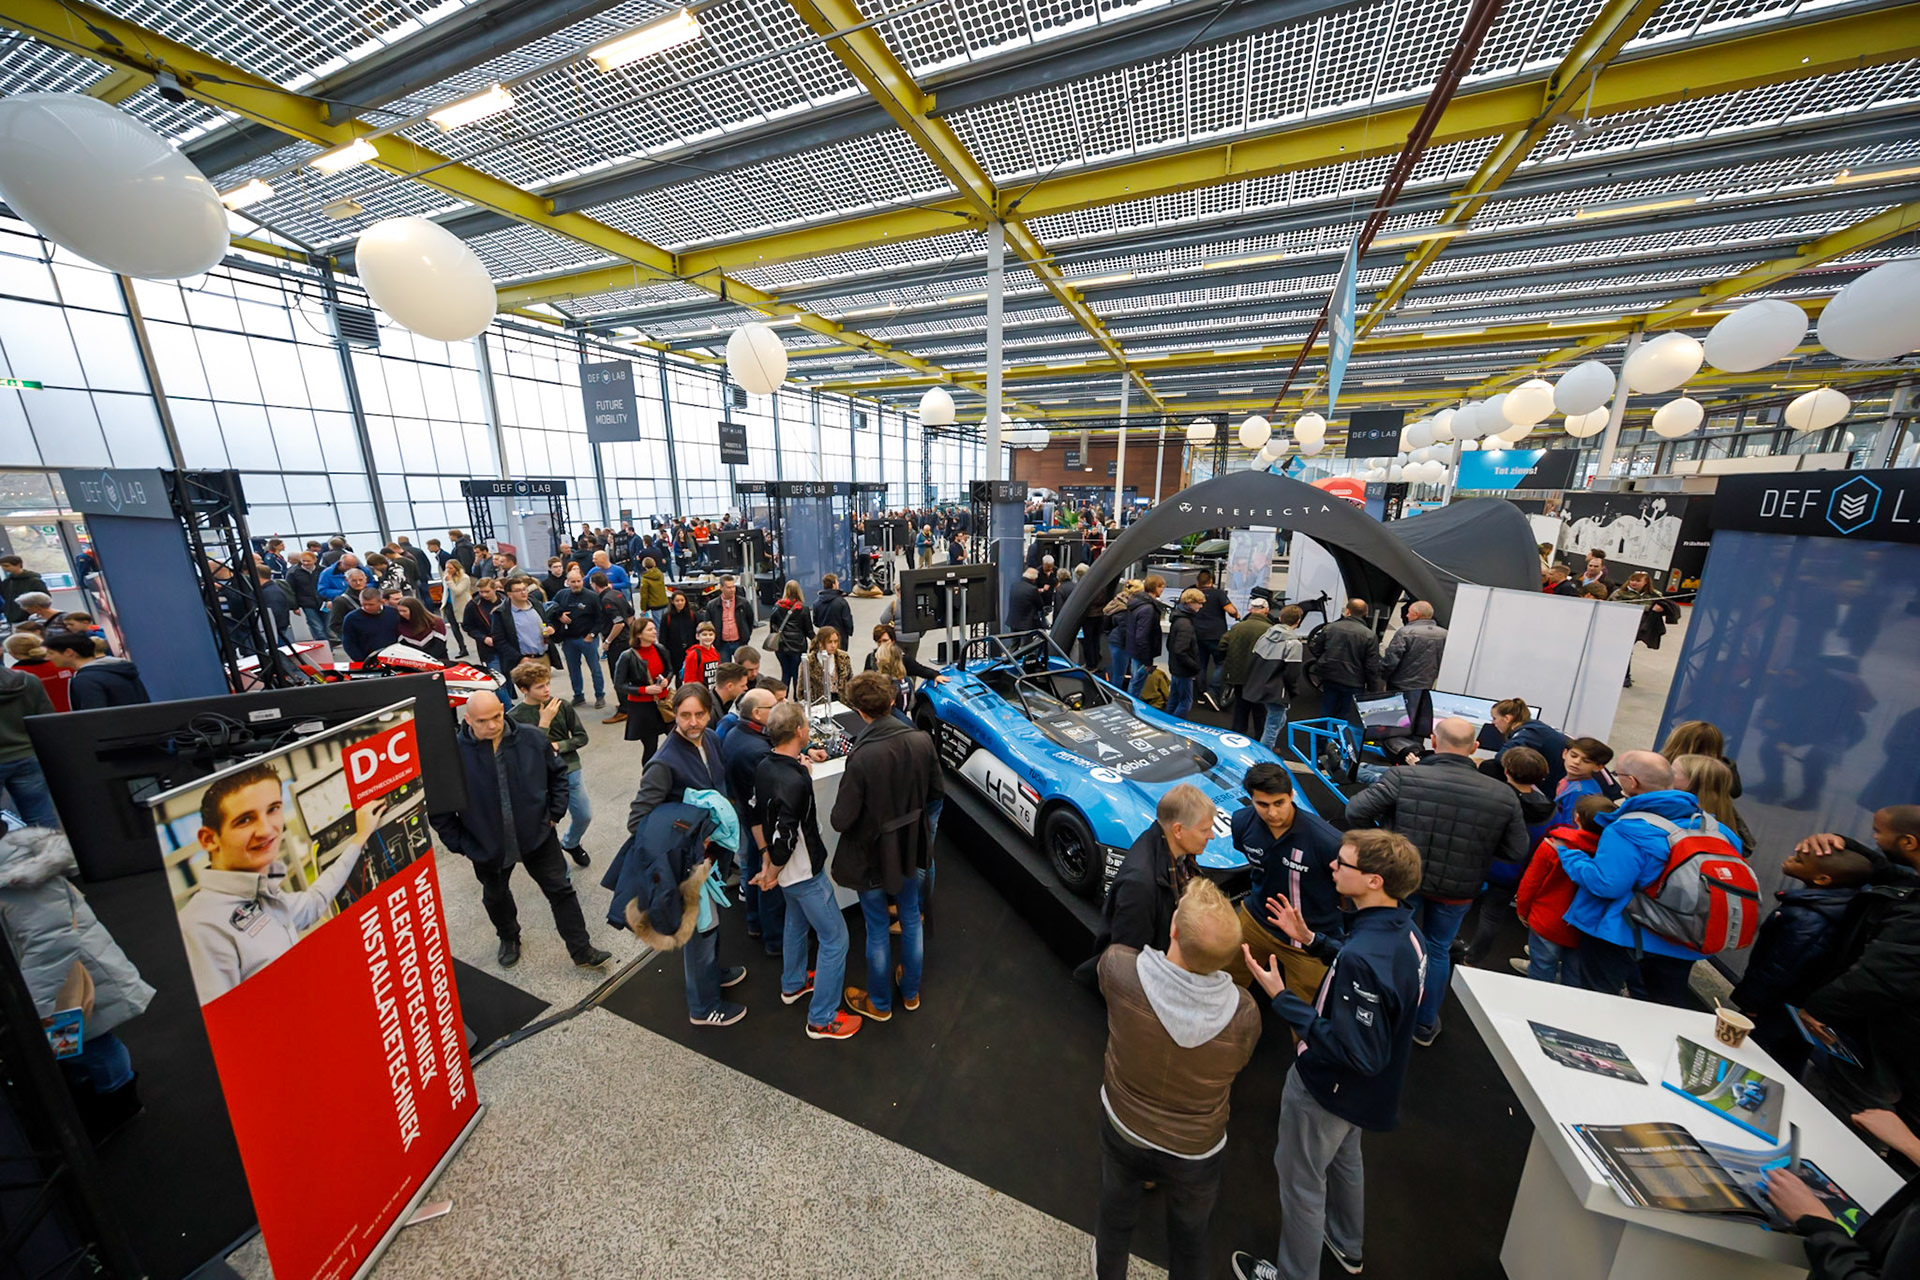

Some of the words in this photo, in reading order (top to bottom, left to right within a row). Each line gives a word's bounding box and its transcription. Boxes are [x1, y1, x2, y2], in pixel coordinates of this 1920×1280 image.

[587, 373, 600, 383] DEF
[611, 371, 626, 381] LAB
[596, 400, 624, 411] FUTURE
[595, 414, 628, 425] MOBILITY
[1352, 431, 1367, 439] DEF
[1381, 430, 1397, 438] LAB
[1494, 467, 1508, 475] Tot
[1509, 466, 1538, 475] ziens!
[80, 481, 102, 503] DEF
[120, 481, 147, 505] LAB
[492, 483, 513, 493] DEF
[531, 484, 551, 493] LAB
[791, 485, 804, 494] DEF
[813, 485, 826, 494] LAB
[999, 485, 1009, 498] DEF
[1014, 485, 1023, 498] LAB
[1760, 489, 1822, 518] DEF
[1200, 504, 1331, 517] TREFECTA
[1109, 758, 1150, 775] Xebia
[985, 769, 1017, 816] H2
[1019, 804, 1030, 823] 76
[387, 886, 438, 1090] ELEKTROTECHNIEK
[414, 867, 466, 1111] WERKTUIGBOUWKUNDE
[359, 905, 421, 1153] INSTALLATIETECHNIEK
